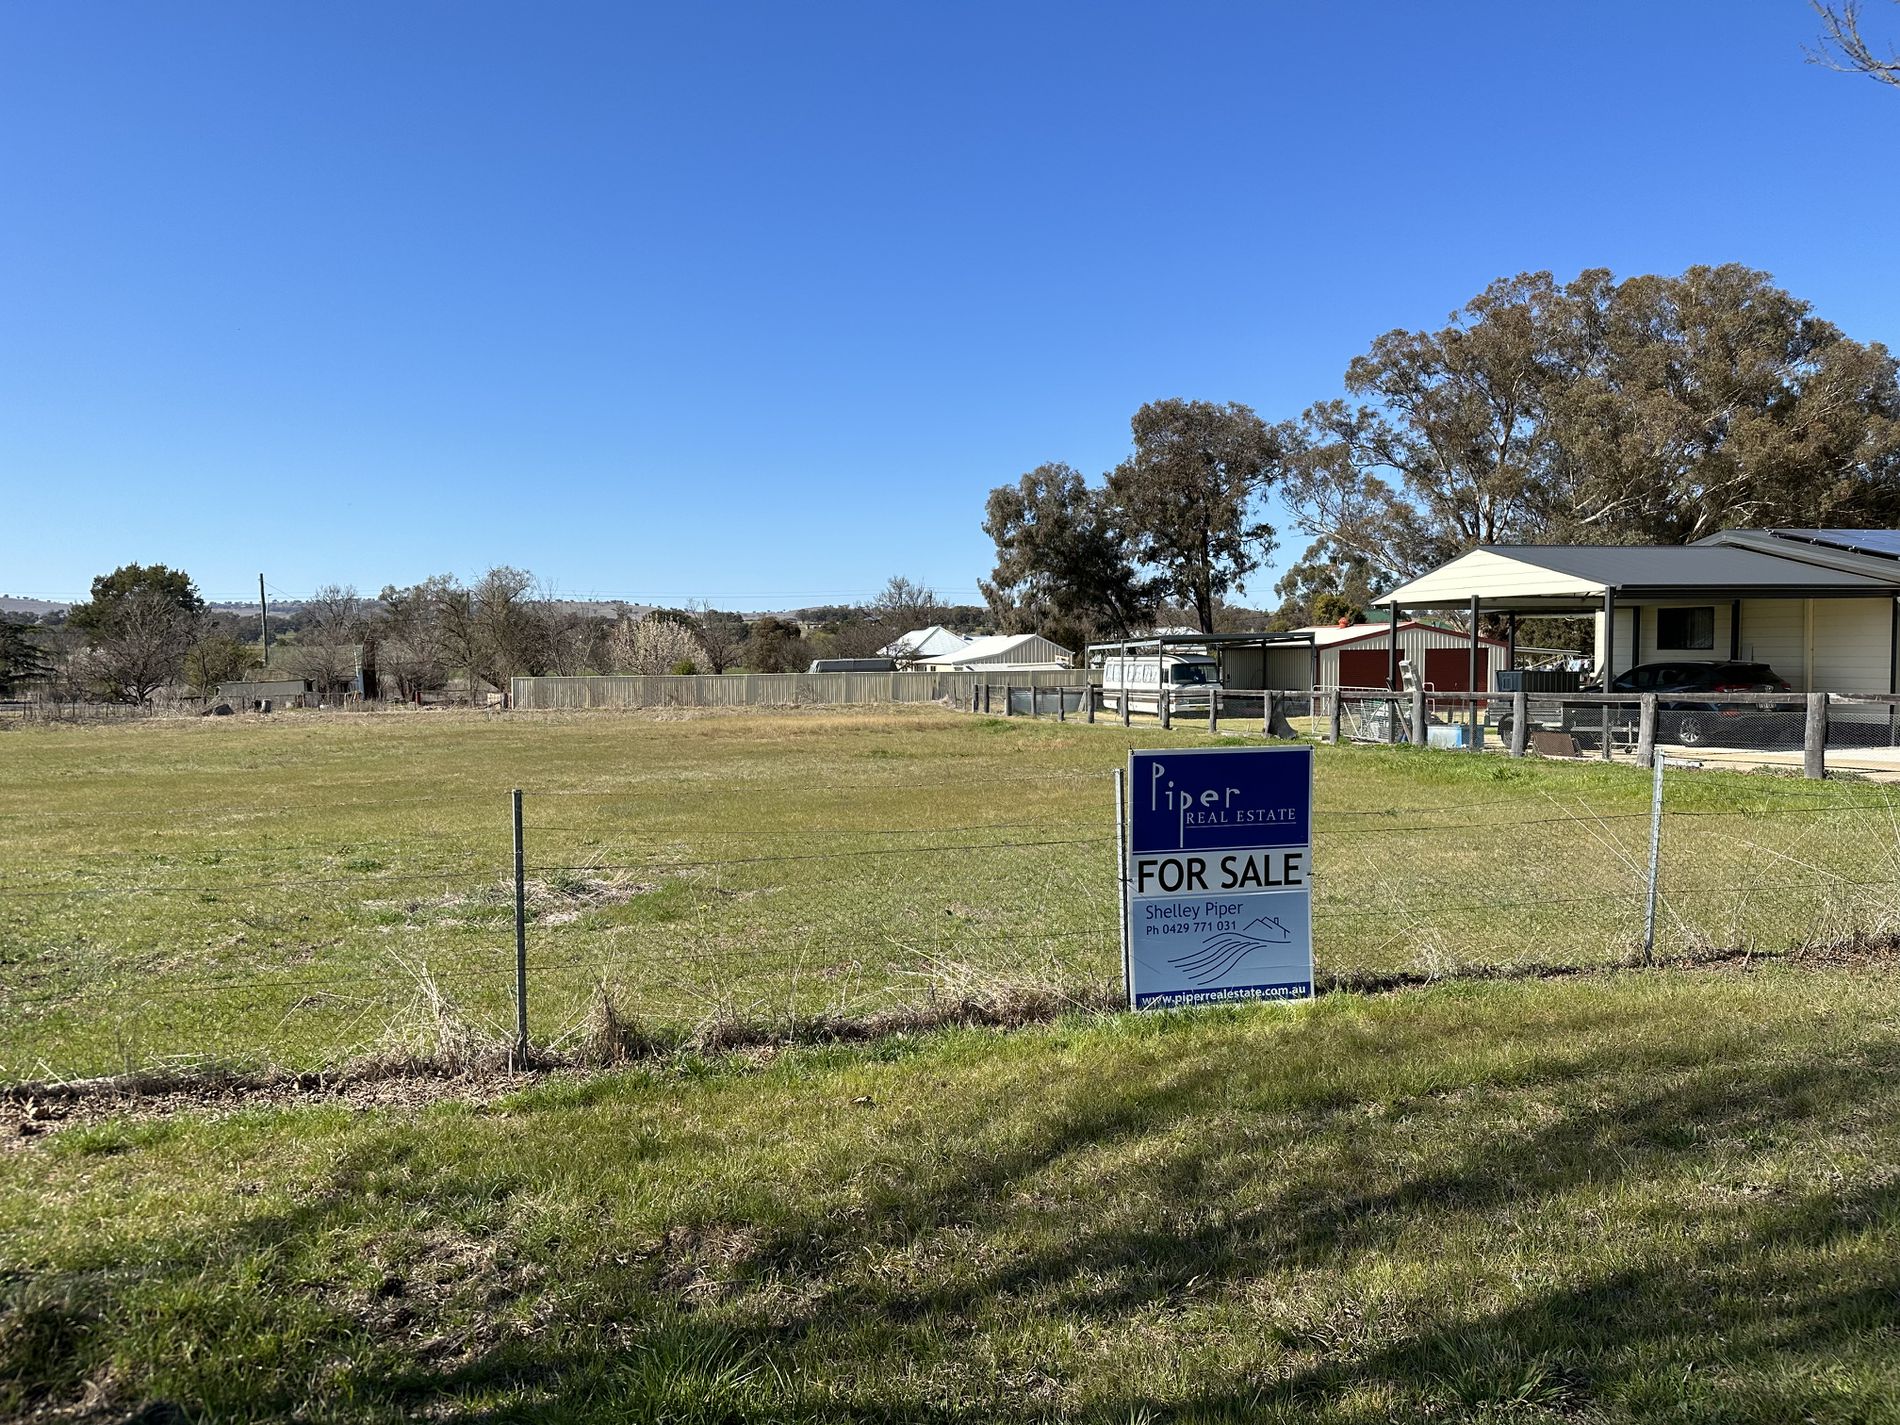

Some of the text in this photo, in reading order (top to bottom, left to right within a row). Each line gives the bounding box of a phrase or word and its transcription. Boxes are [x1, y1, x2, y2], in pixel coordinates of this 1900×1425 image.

[1152, 762, 1240, 848] Piper
[1186, 808, 1296, 824] REAL ESTATE
[1138, 853, 1303, 893] FOR SALE
[1146, 902, 1244, 920] Shelley Piper
[1146, 920, 1237, 935] Ph 0429 771 031
